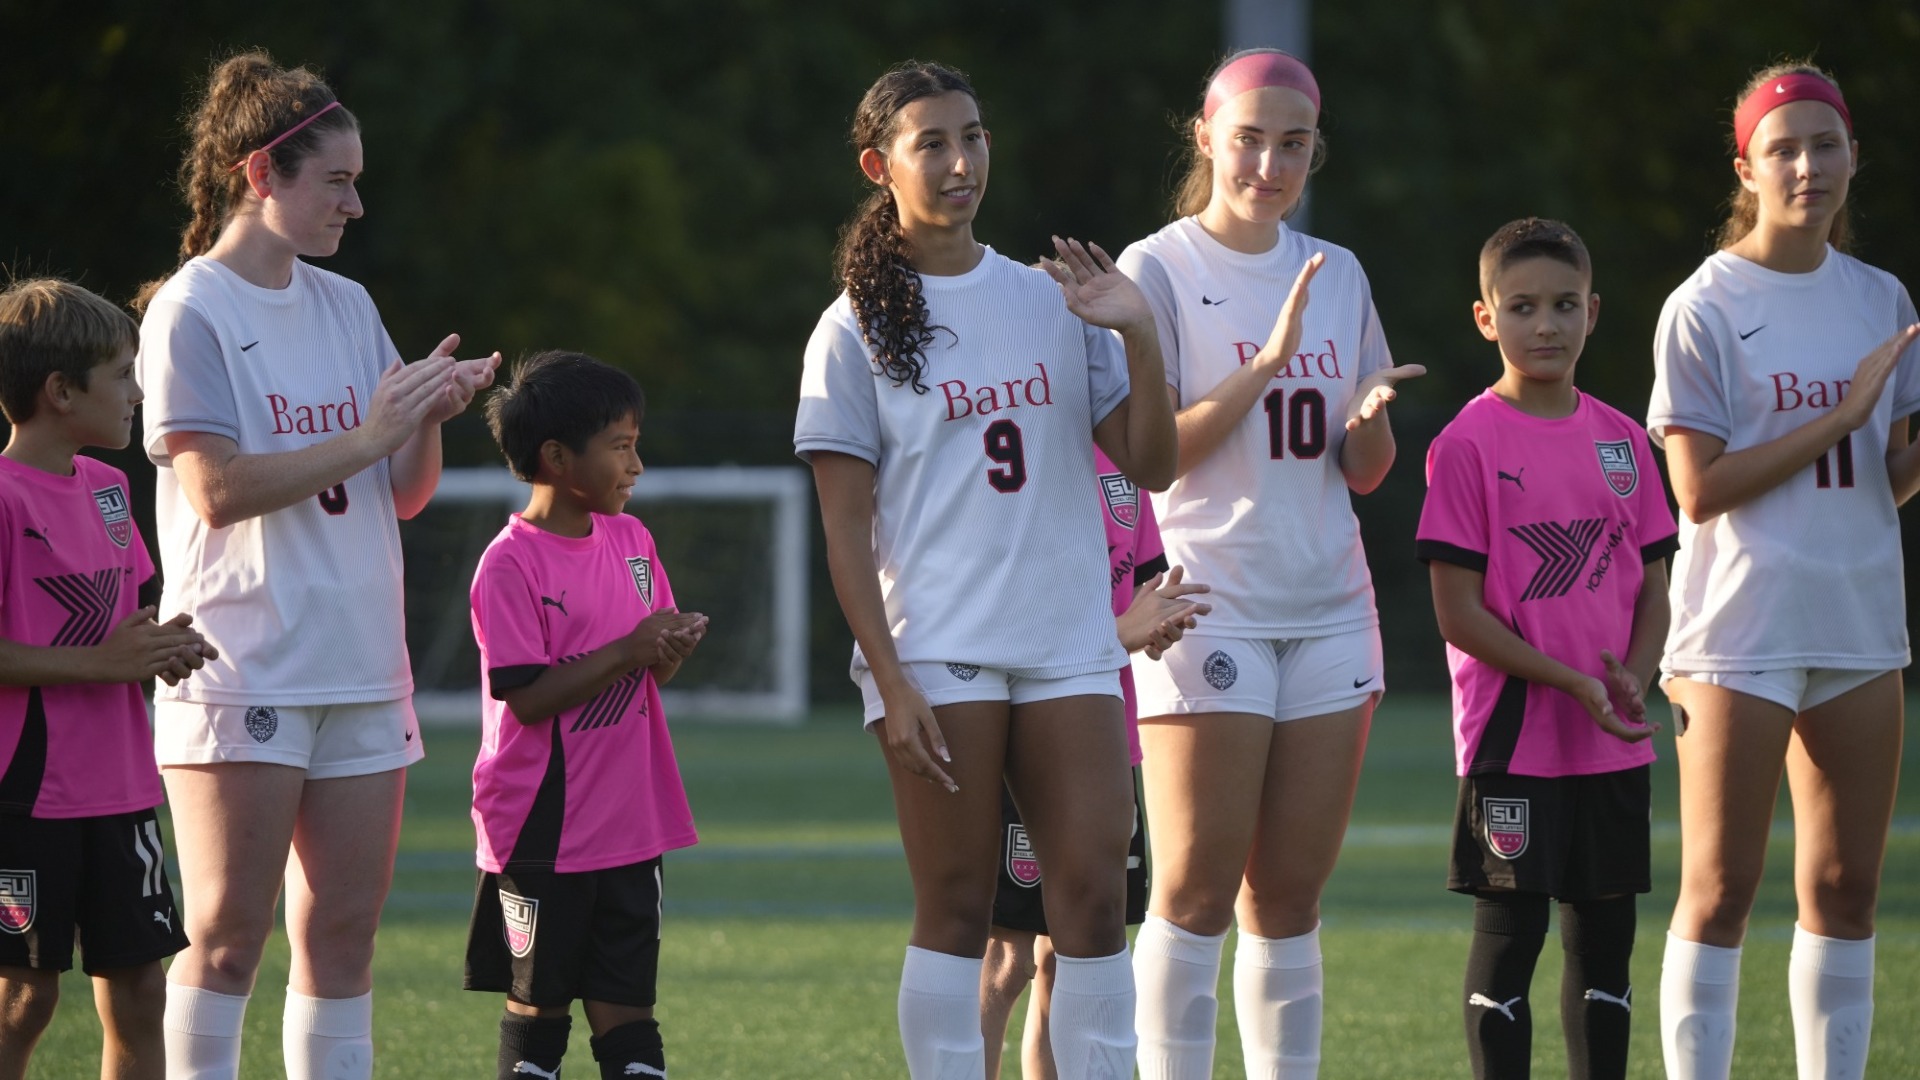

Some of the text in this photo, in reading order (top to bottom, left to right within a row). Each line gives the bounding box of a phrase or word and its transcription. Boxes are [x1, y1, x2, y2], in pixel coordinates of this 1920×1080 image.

[937, 363, 1054, 422] Bard
[1768, 372, 1851, 413] Bar
[266, 386, 361, 435] Bard
[1264, 388, 1326, 460] 10
[983, 419, 1027, 493] 9
[1600, 448, 1628, 463] SU
[1107, 479, 1134, 496] SU
[97, 494, 124, 514] SU
[1491, 806, 1521, 823] SU
[1016, 833, 1031, 850] S
[0, 878, 28, 896] SU
[504, 901, 530, 923] SU
